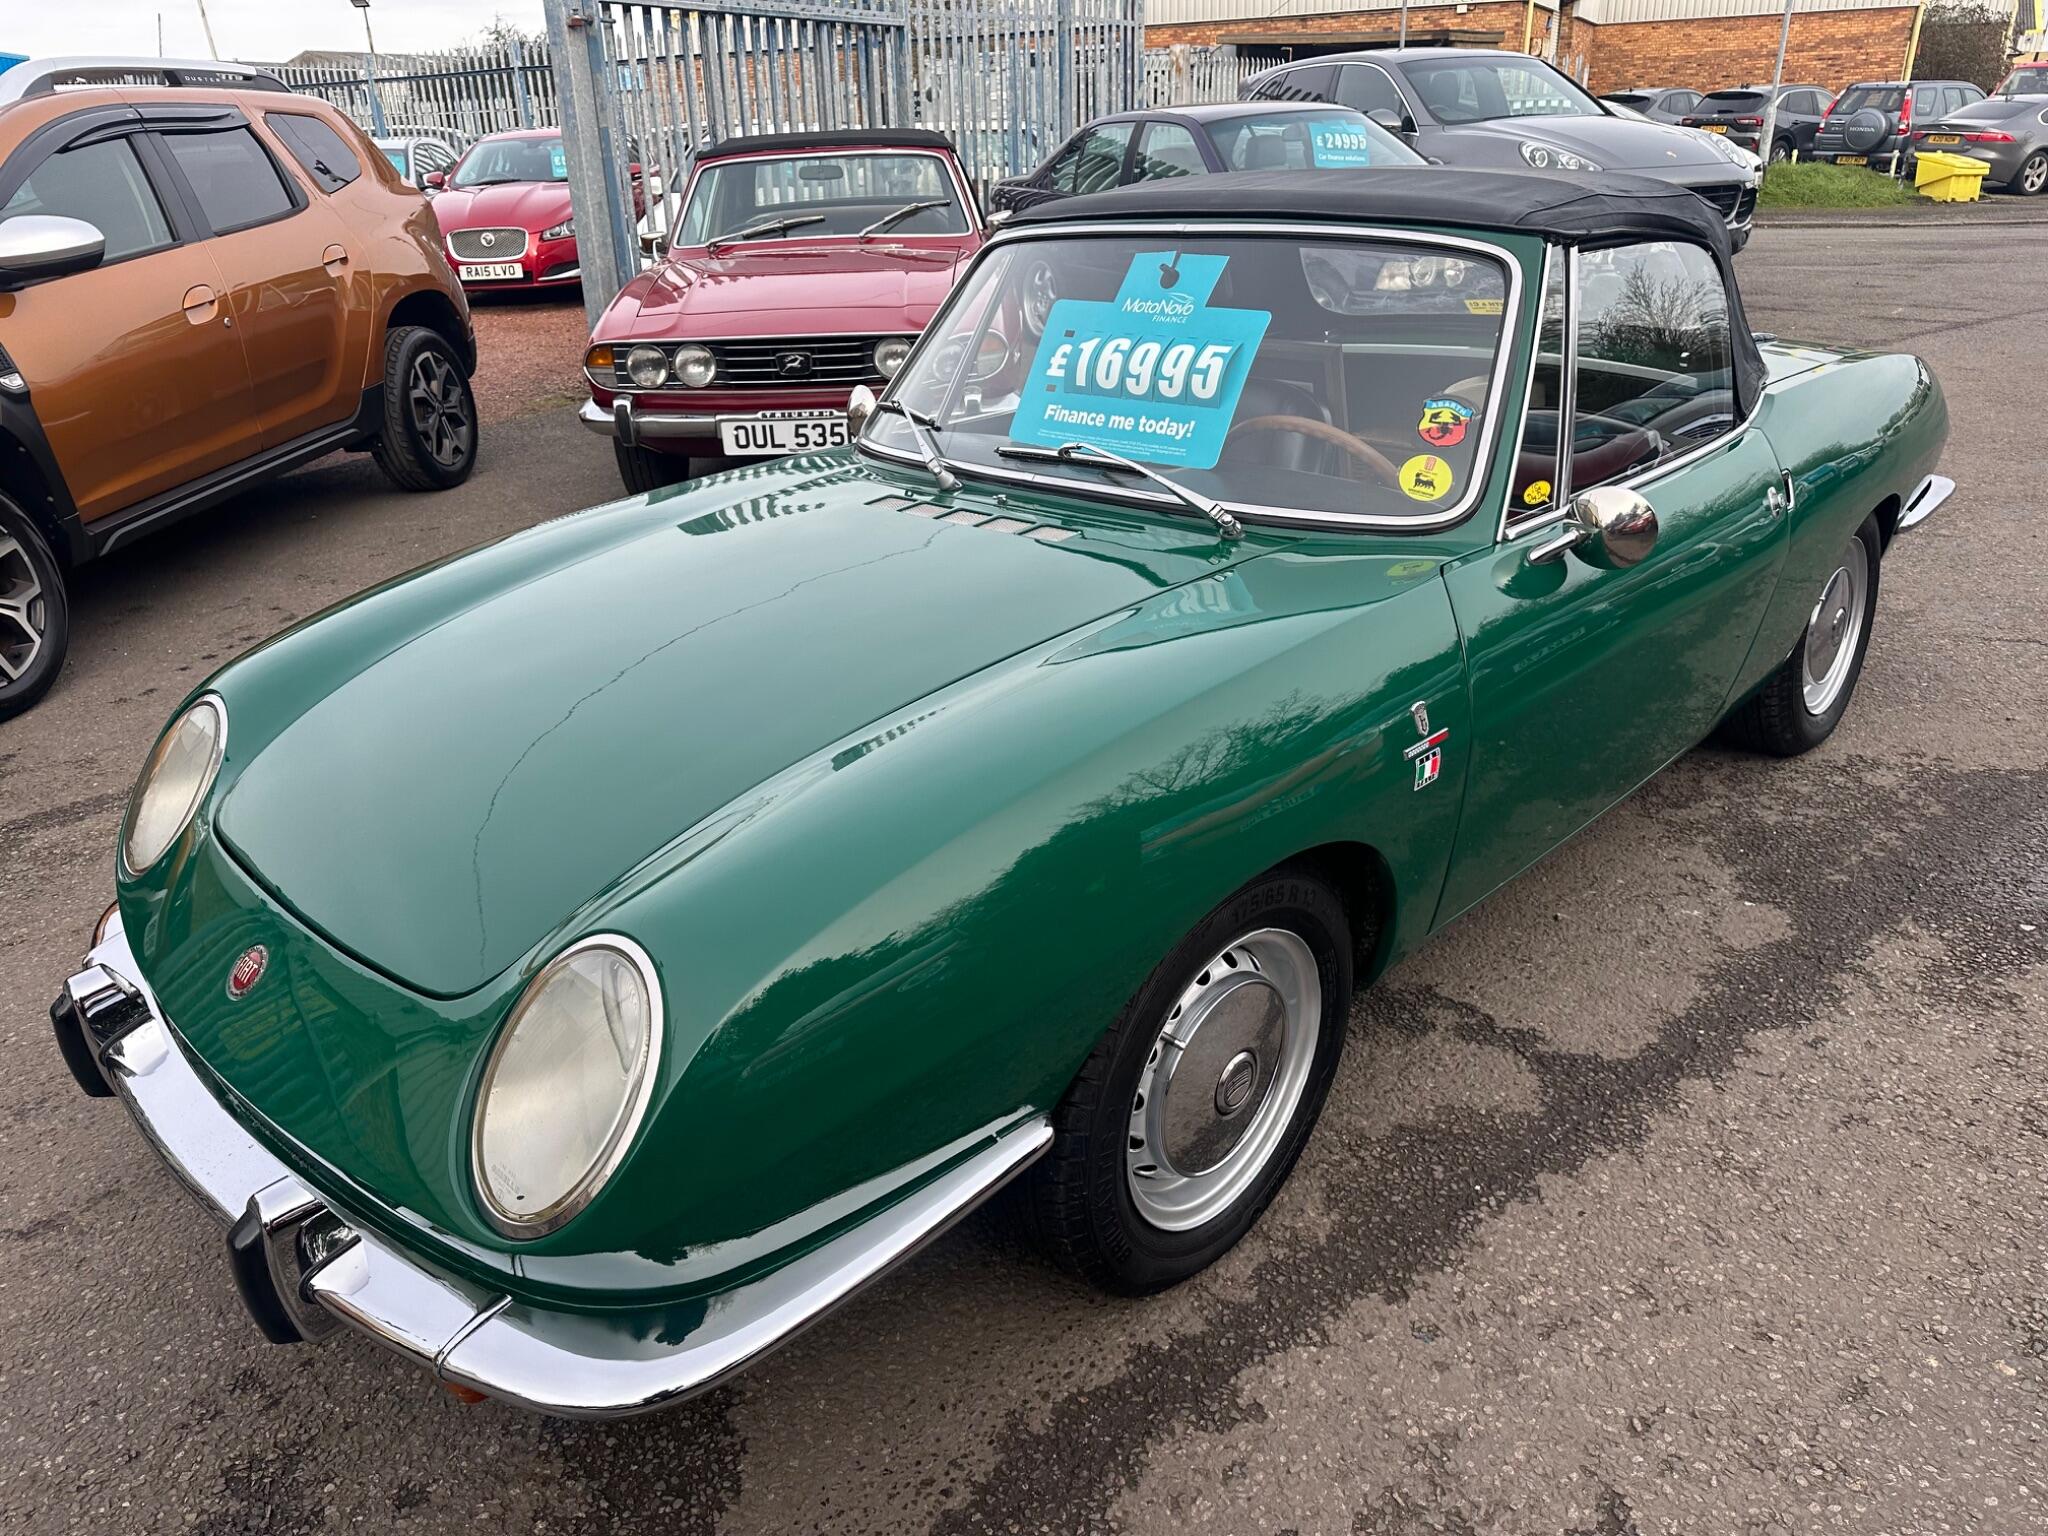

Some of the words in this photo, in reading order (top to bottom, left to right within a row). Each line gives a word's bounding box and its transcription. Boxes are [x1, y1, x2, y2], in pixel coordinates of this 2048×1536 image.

[465, 266, 491, 278] RA15
[493, 265, 516, 276] LVO
[1122, 297, 1194, 316] MotoNovo
[1152, 314, 1188, 324] FINANCE
[1045, 337, 1233, 399] £16995
[1431, 400, 1465, 416] ABARTH
[1044, 404, 1104, 426] Finance
[1108, 414, 1135, 431] me
[1138, 415, 1196, 440] today!
[733, 424, 787, 449] OUL
[233, 956, 260, 984] FIAT
